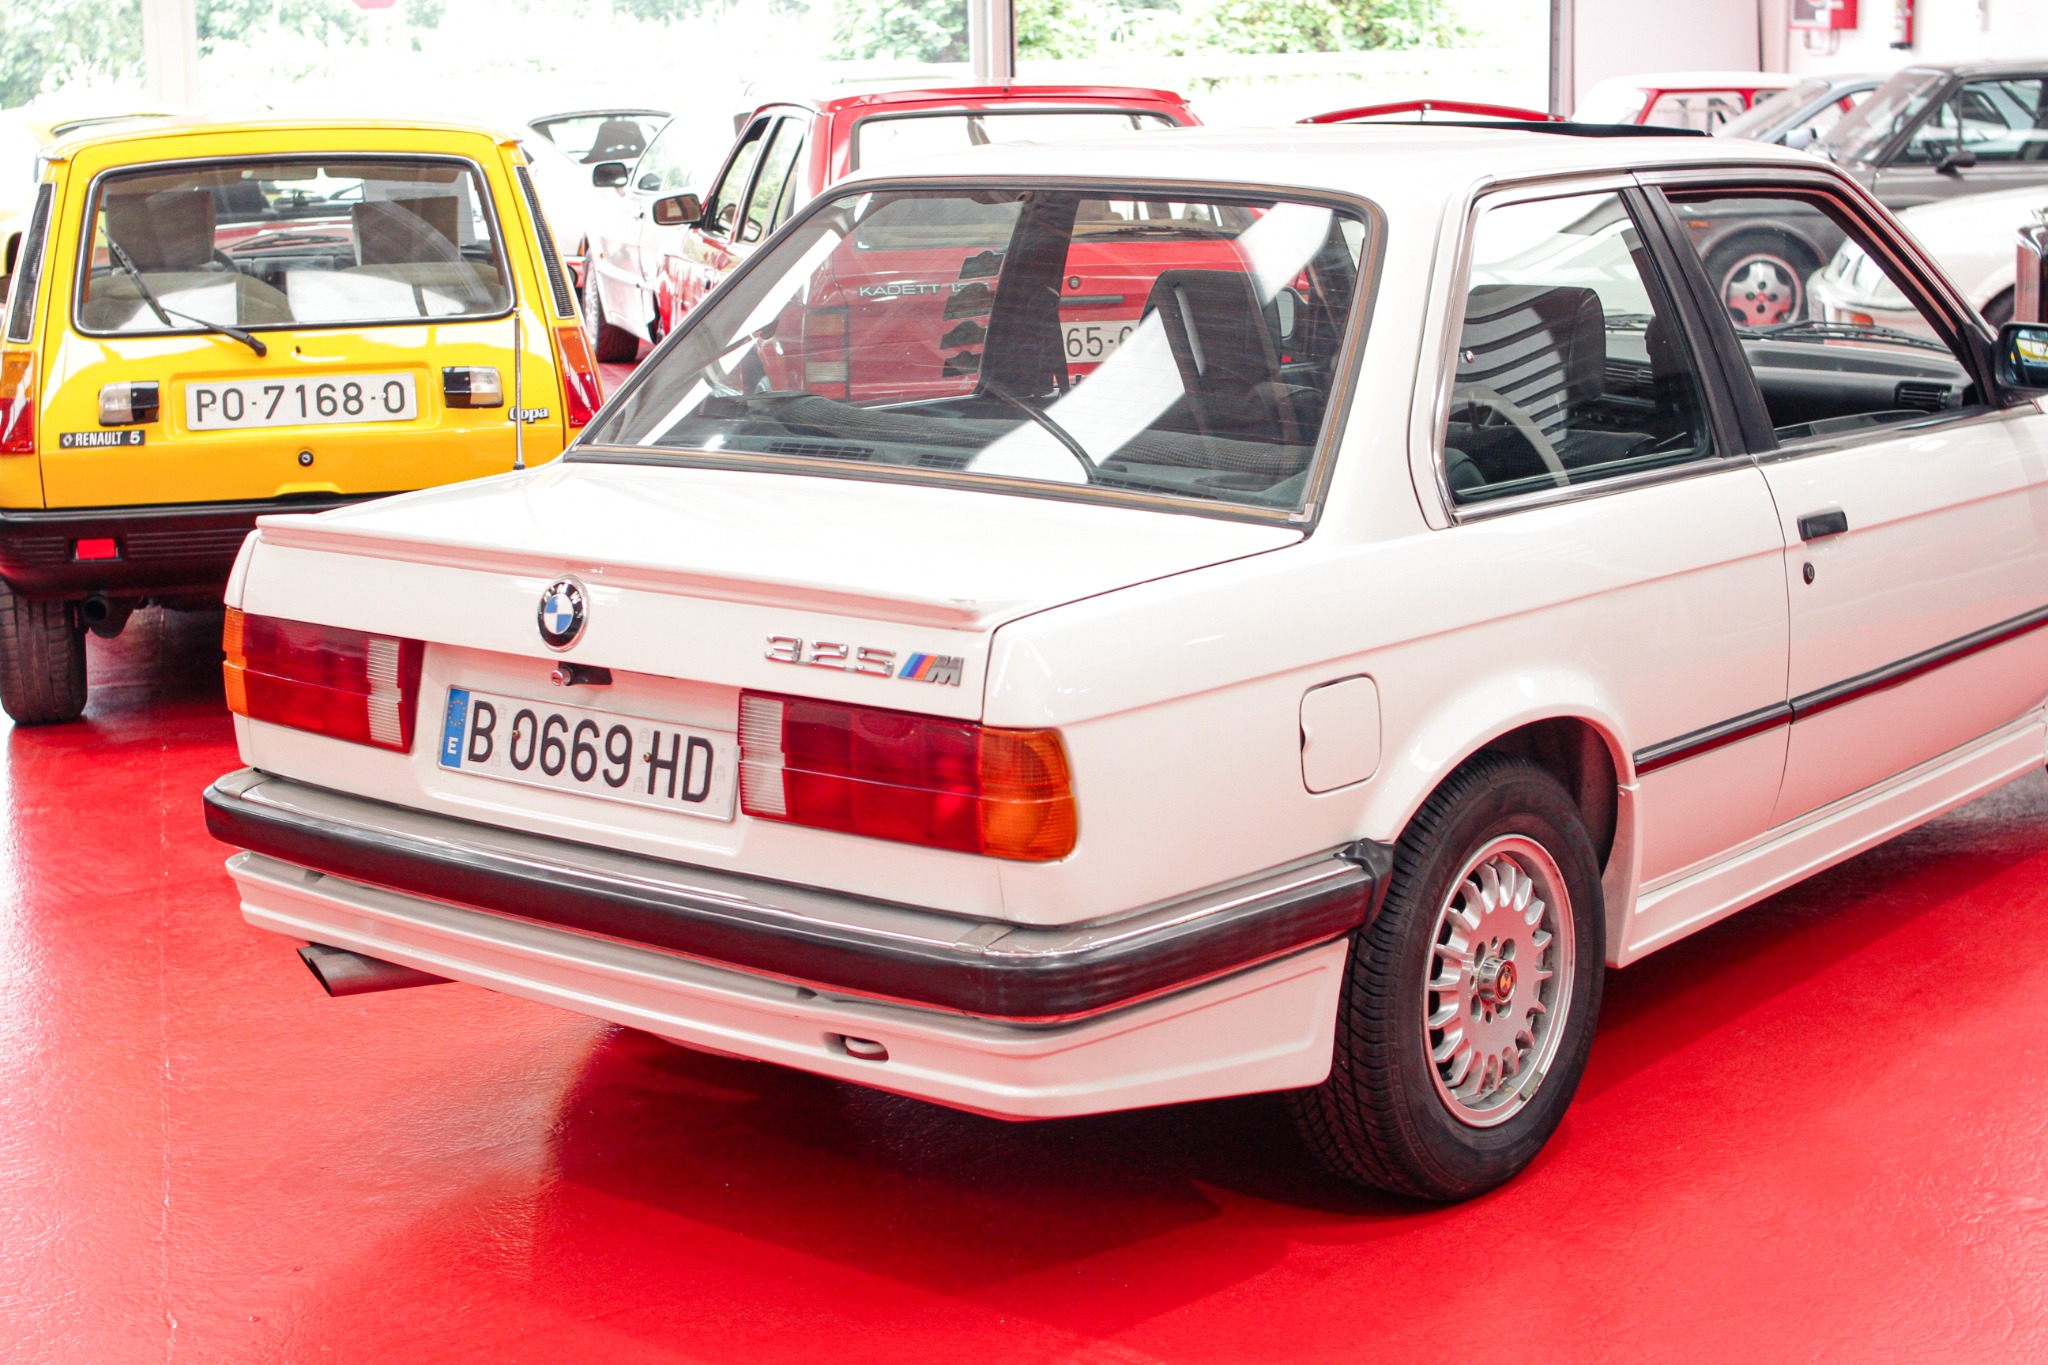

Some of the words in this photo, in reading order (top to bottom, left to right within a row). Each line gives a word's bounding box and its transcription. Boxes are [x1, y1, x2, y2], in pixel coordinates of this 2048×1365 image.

[859, 283, 939, 297] KADETT
[75, 431, 123, 447] RENAULT
[129, 431, 141, 445] 5
[543, 582, 582, 604] BMW
[764, 633, 897, 678] 325
[446, 736, 459, 755] E
[468, 700, 497, 763] B
[510, 708, 633, 788] 0669
[646, 730, 714, 803] HD
